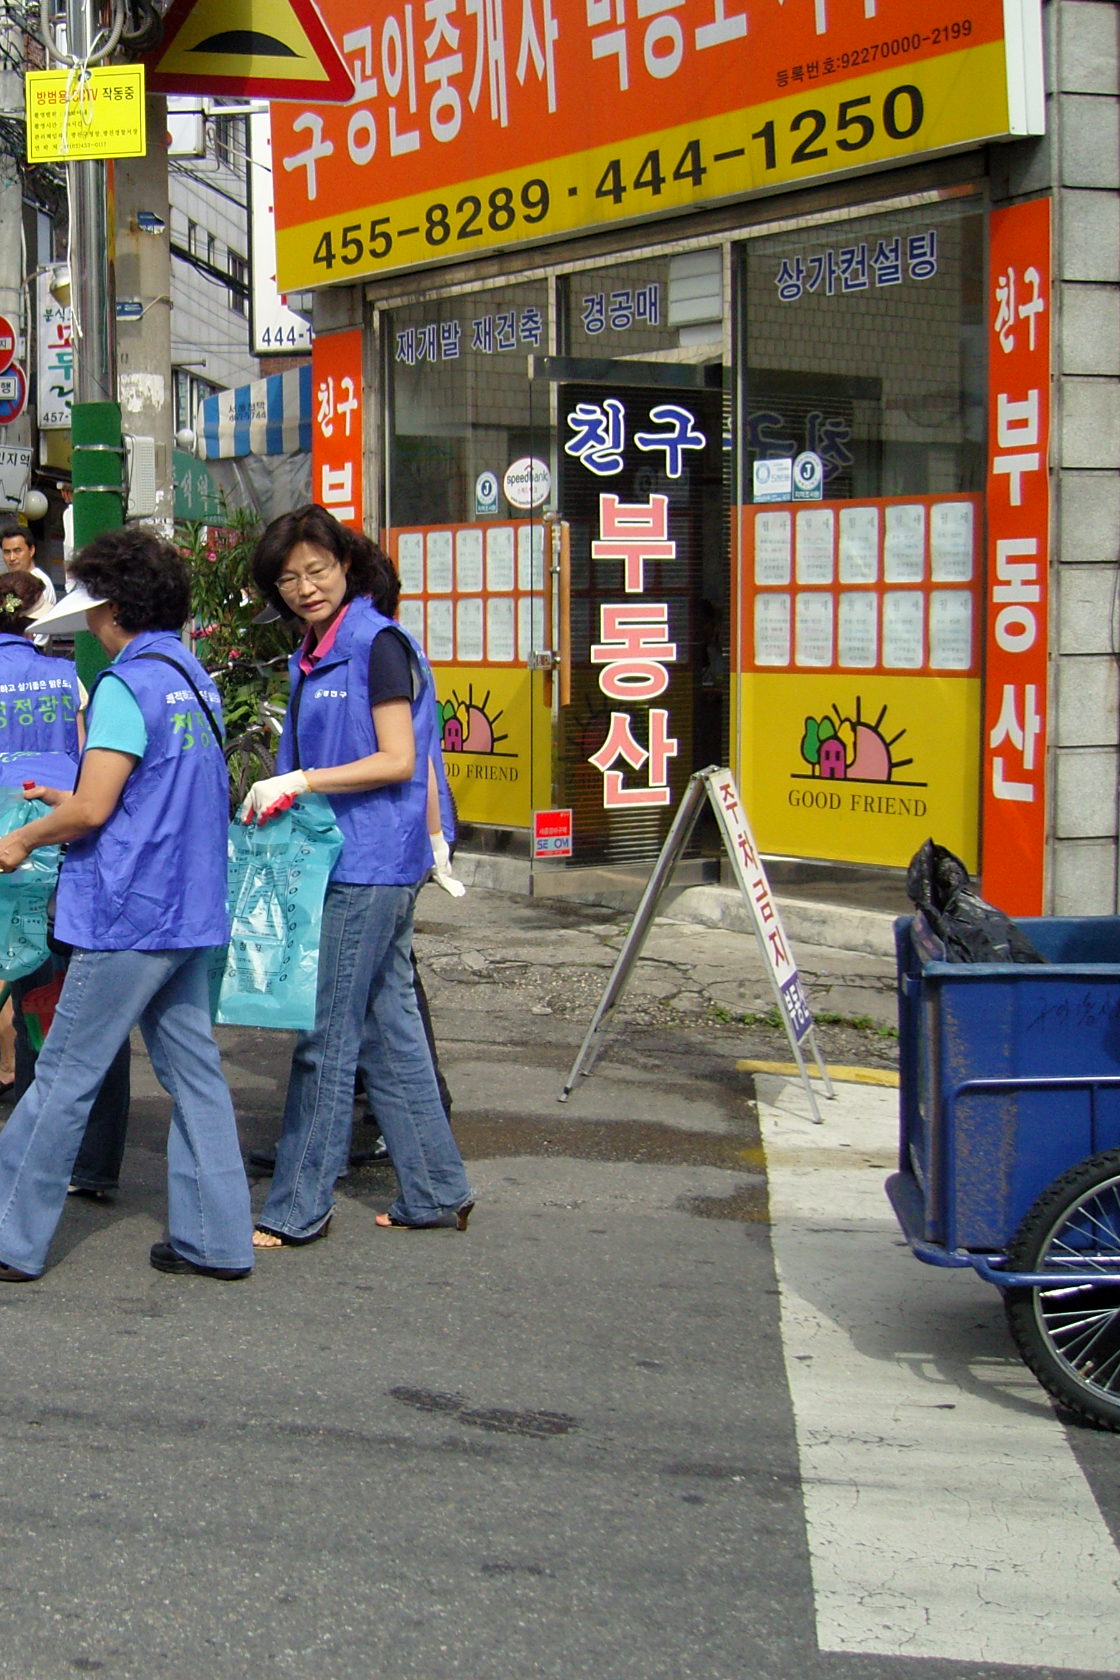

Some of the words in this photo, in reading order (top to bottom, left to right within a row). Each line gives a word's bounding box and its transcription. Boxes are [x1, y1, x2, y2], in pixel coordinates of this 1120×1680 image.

[36, 90, 69, 106] 방범용
[102, 85, 134, 102] 작동중
[313, 178, 551, 270] 455-8289
[594, 84, 925, 205] 444-1250
[776, 230, 938, 301] 상가컨설팅
[395, 319, 461, 366] 재개발
[471, 307, 544, 354] 재건축
[581, 283, 660, 335] 경공매
[993, 265, 1045, 354] 친구
[42, 412, 71, 424] 457-
[317, 376, 358, 438] 친구
[565, 398, 707, 479] 친구
[506, 469, 550, 487] speedank
[989, 389, 1043, 803] 부동산
[588, 493, 679, 810] 부동산
[466, 764, 520, 782] FRIEND
[788, 789, 842, 811] GOOD
[851, 794, 928, 818] FRIEND
[536, 838, 570, 850] SEOM
[719, 783, 790, 969] 주차금지
